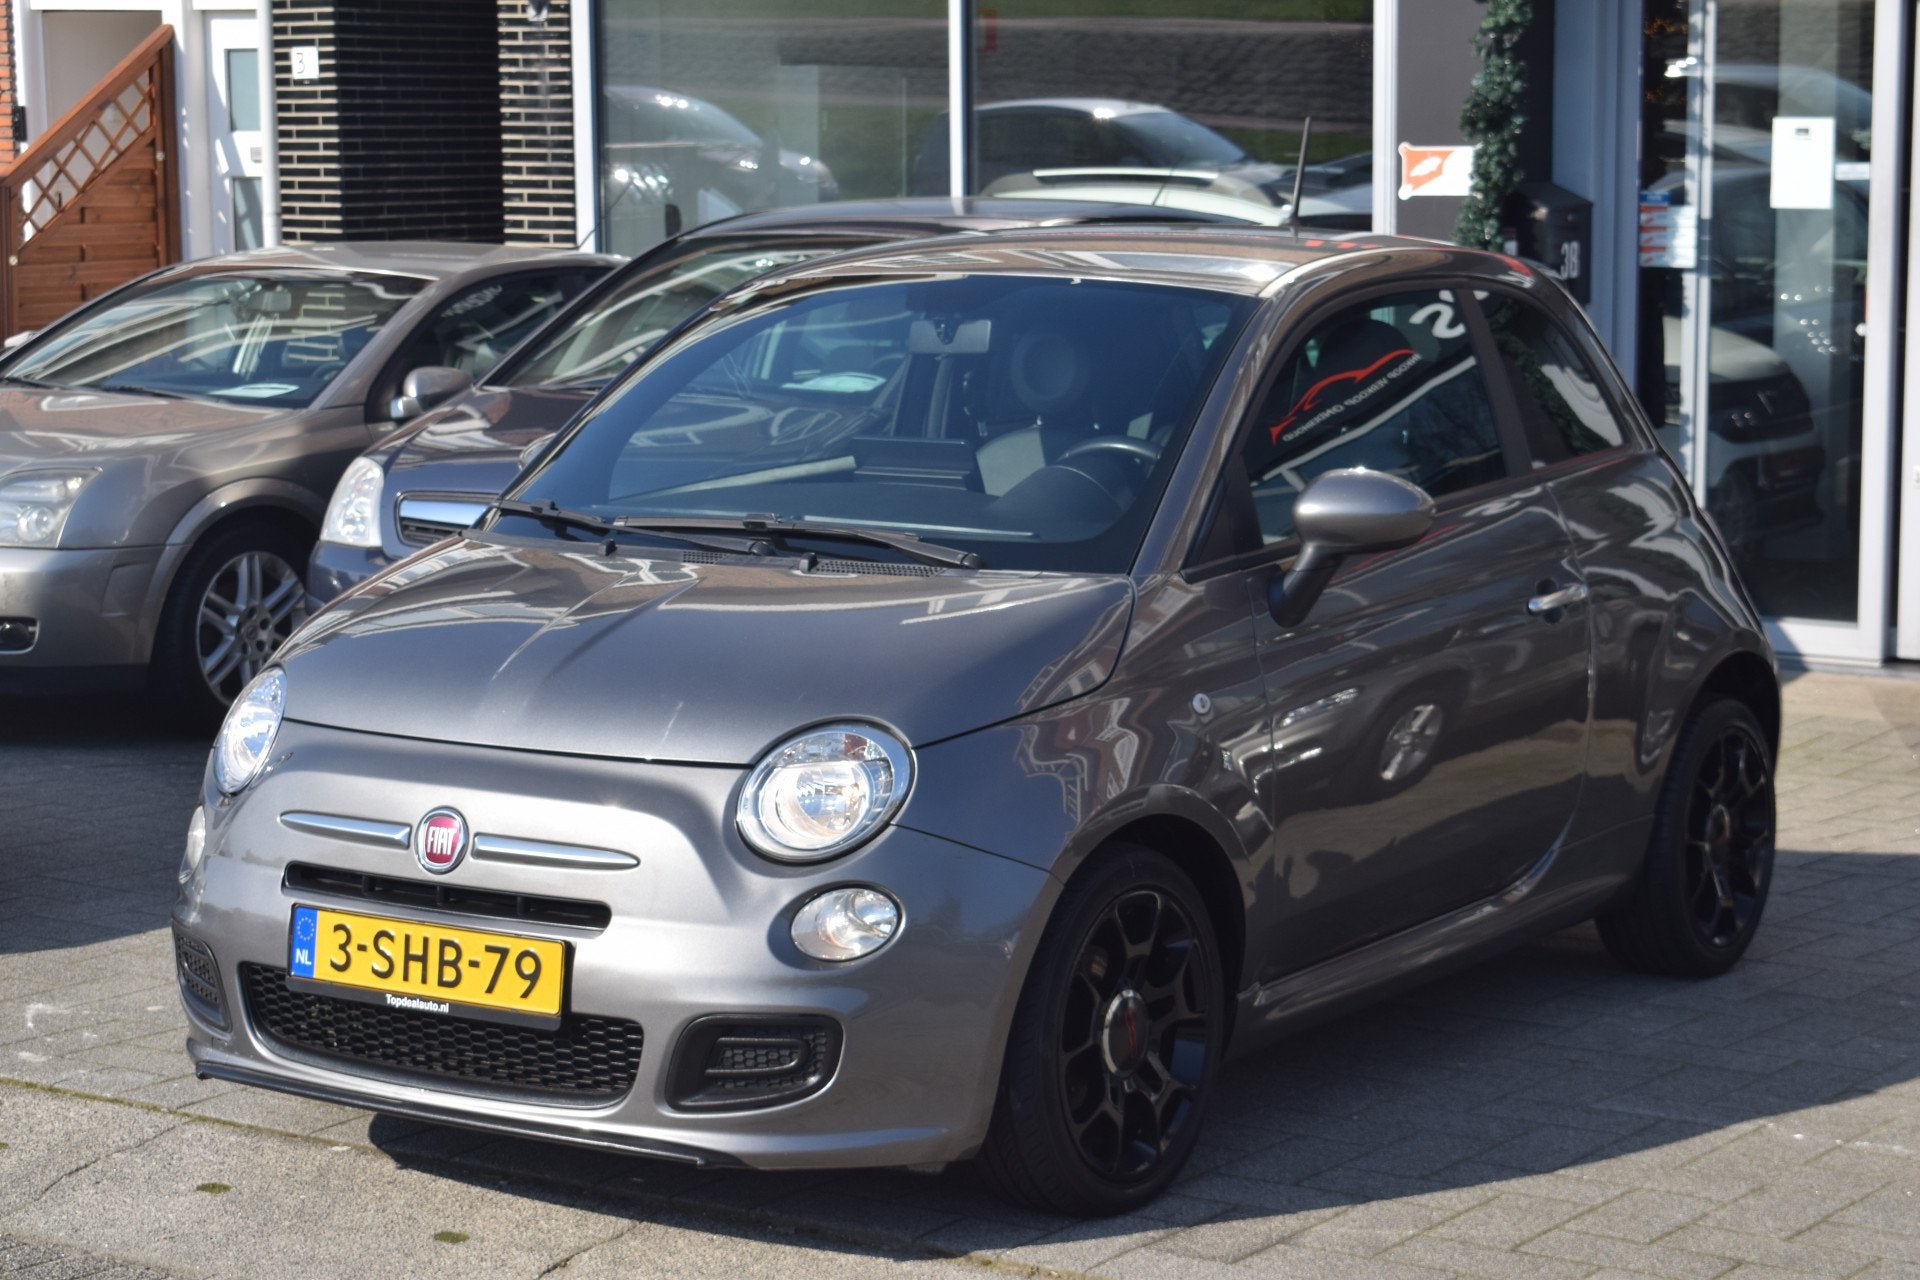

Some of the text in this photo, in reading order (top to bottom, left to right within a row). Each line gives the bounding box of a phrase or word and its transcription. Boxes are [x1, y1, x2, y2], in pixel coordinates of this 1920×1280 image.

[296, 52, 305, 74] 3
[427, 826, 457, 855] FIAT
[295, 949, 312, 966] NL
[330, 923, 542, 999] 3-SHB-79
[385, 993, 449, 1013] Topdealauto.nl
